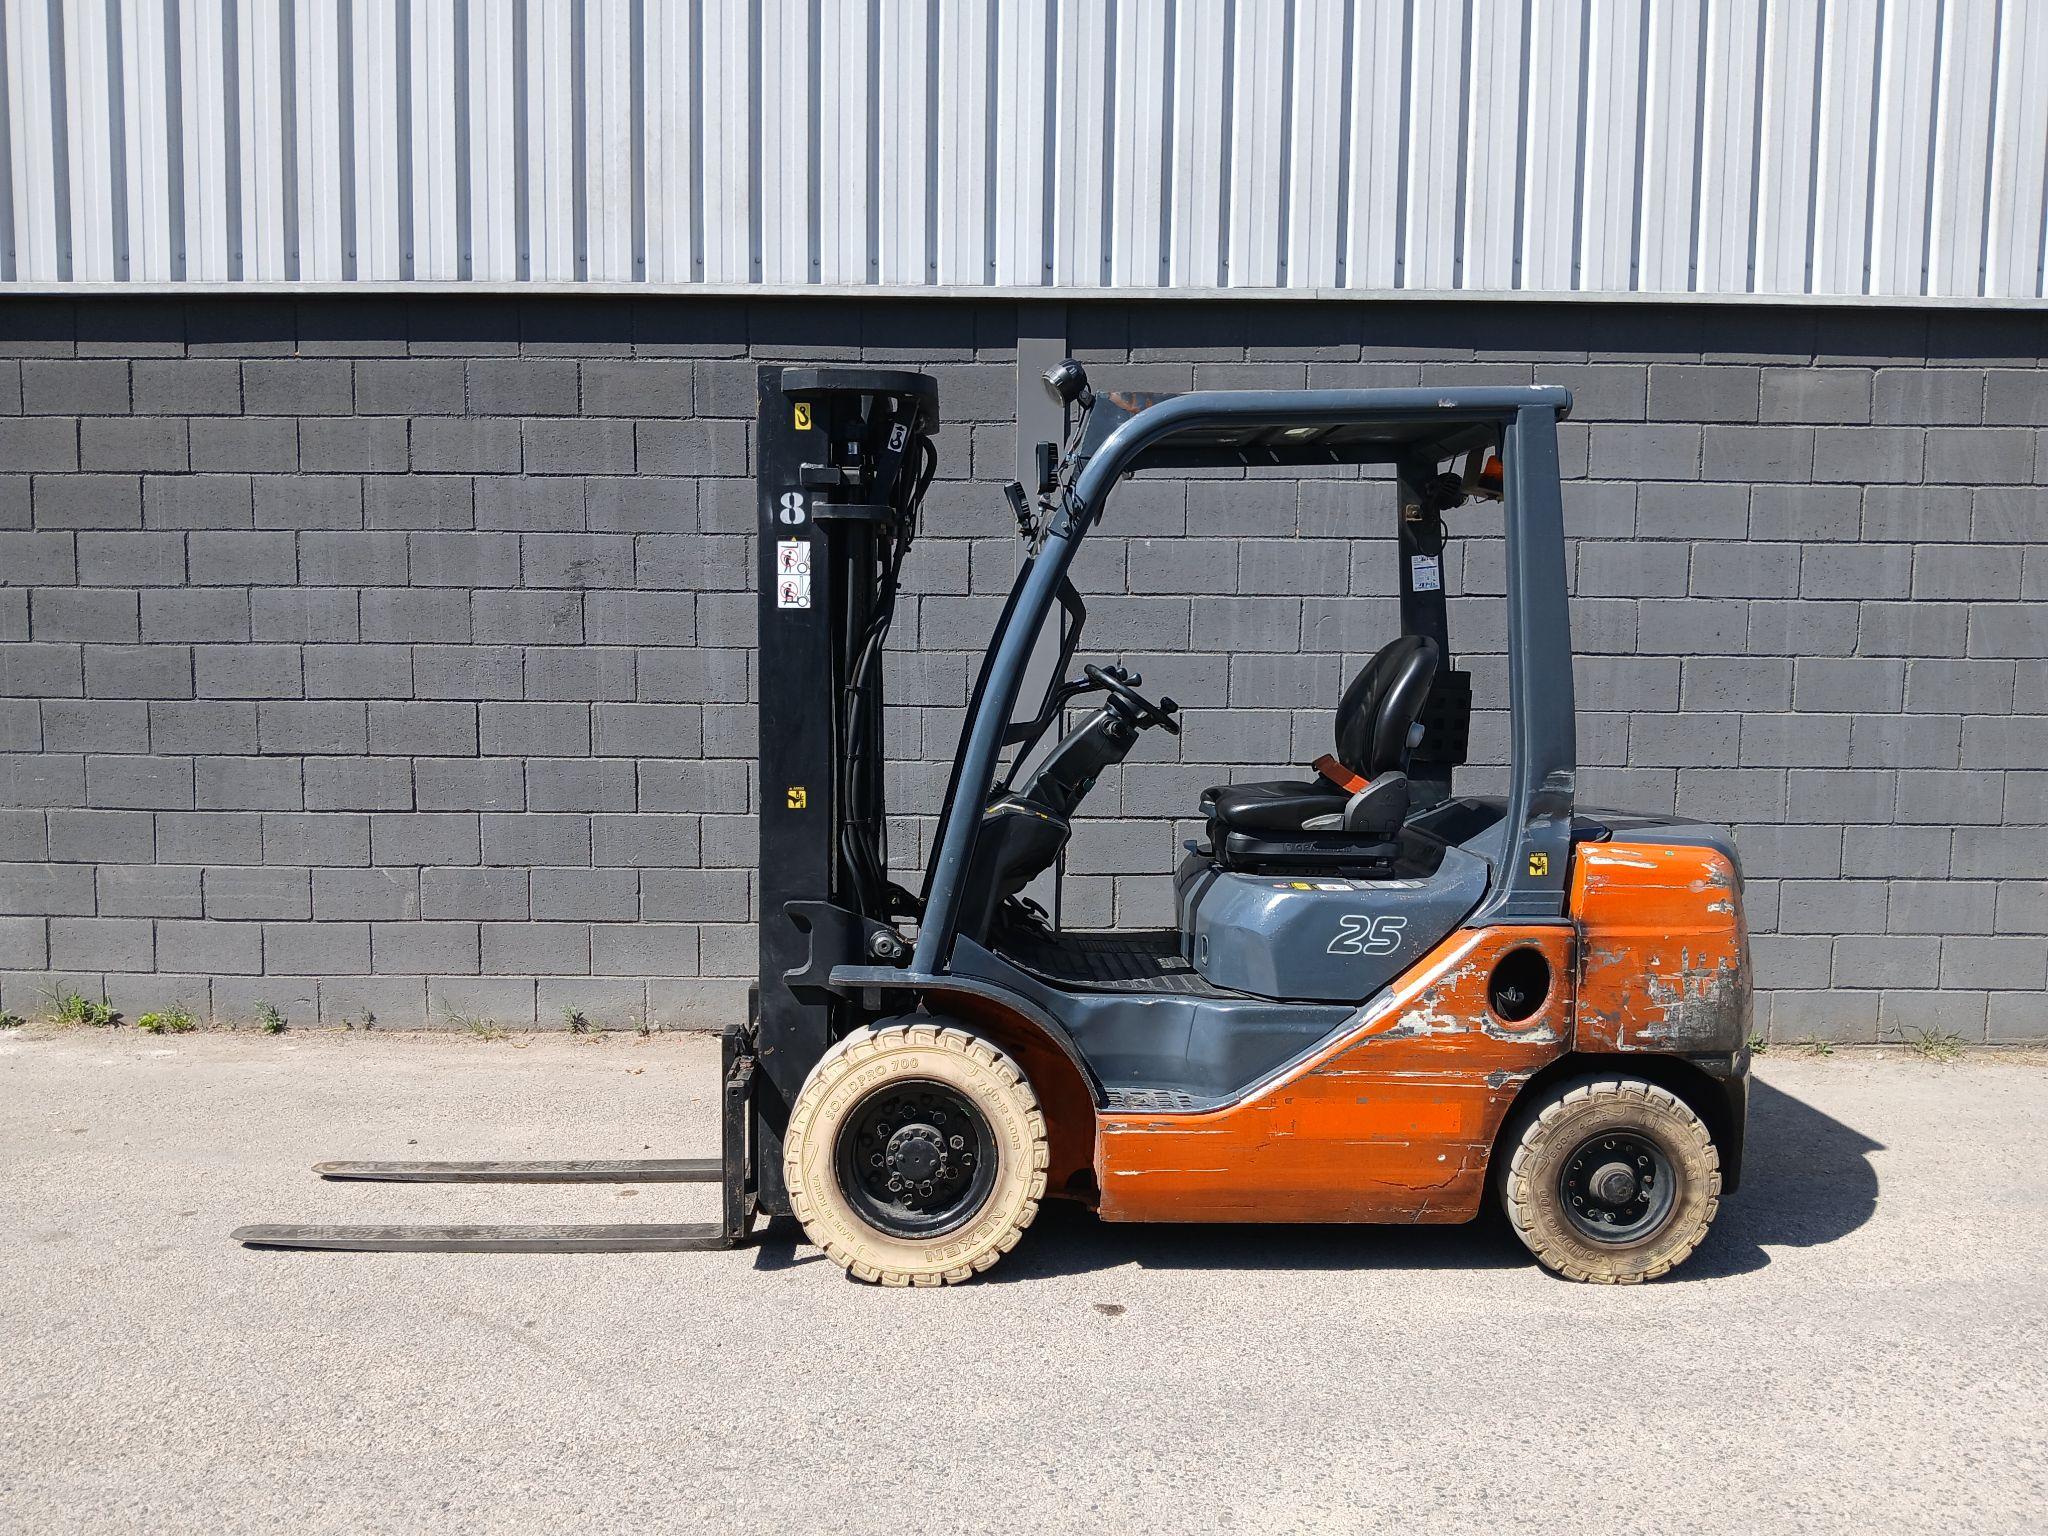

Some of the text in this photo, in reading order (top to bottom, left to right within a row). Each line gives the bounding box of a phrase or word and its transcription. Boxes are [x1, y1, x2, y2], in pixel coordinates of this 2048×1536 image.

[780, 492, 806, 525] 8
[1326, 914, 1408, 956] 25
[825, 1065, 887, 1121] SOLIDPRO
[923, 1206, 1007, 1262] NEXEN
